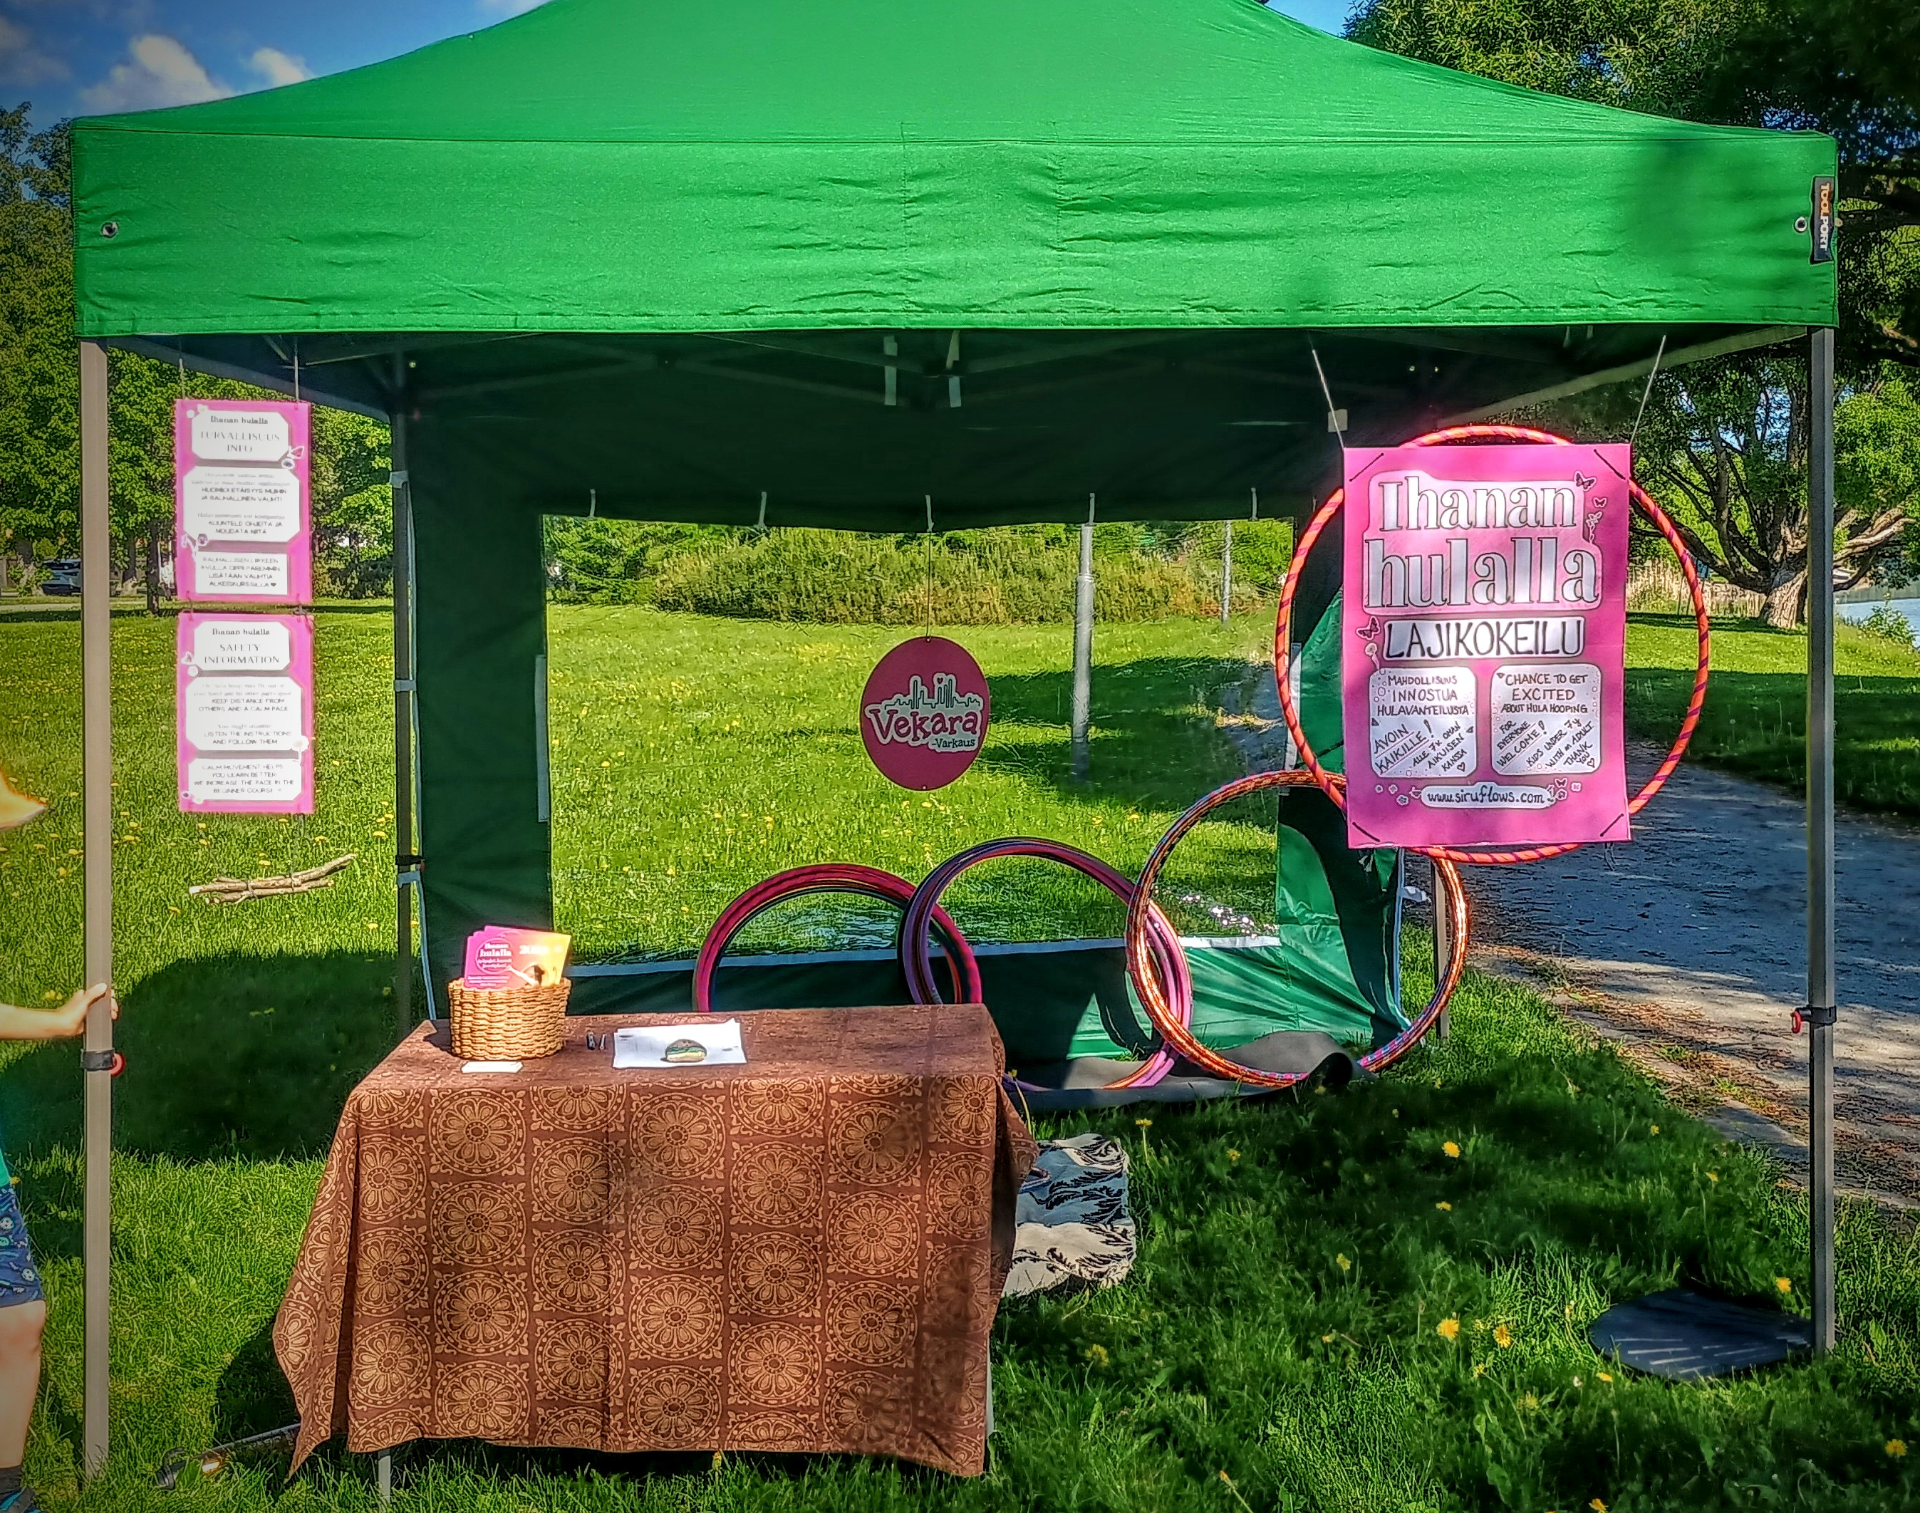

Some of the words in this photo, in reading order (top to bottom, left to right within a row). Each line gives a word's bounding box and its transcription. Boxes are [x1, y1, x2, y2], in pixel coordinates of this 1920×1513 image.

[1820, 182, 1831, 251] TOOLPORT
[226, 444, 253, 453] INFO
[1378, 476, 1577, 532] Ihanan
[1364, 537, 1599, 608] hulalla
[219, 643, 260, 652] SAFETY
[1386, 619, 1582, 659] LAJIKOKEILU
[204, 656, 280, 664] INFORMATION
[1505, 673, 1551, 686] CHANCE
[1553, 674, 1567, 684] TO
[1569, 674, 1588, 684] GET
[1393, 688, 1458, 702] INNOSTUA
[1512, 688, 1576, 701] EXCITED
[1377, 704, 1469, 716] HULAVANTEILUSTA
[1500, 704, 1526, 713] ABOUT
[1526, 703, 1548, 713] HULA
[1550, 704, 1588, 713] HOOPING
[869, 708, 977, 741] Vekara
[1496, 720, 1531, 750] EVERYONE
[1500, 720, 1517, 734] FOR
[1374, 723, 1410, 754] AVOIN
[1526, 748, 1544, 767] KIDS
[1544, 729, 1568, 751] UNDER
[1545, 748, 1565, 768] WITH
[1572, 720, 1595, 745] ADULT
[1413, 751, 1430, 767] ALLE
[1428, 733, 1465, 769] AIKUISEN
[1441, 748, 1468, 772] KANSSA
[1563, 741, 1593, 766] THANK
[1576, 751, 1591, 765] YOU
[1427, 784, 1545, 804] www.siruflows.com
